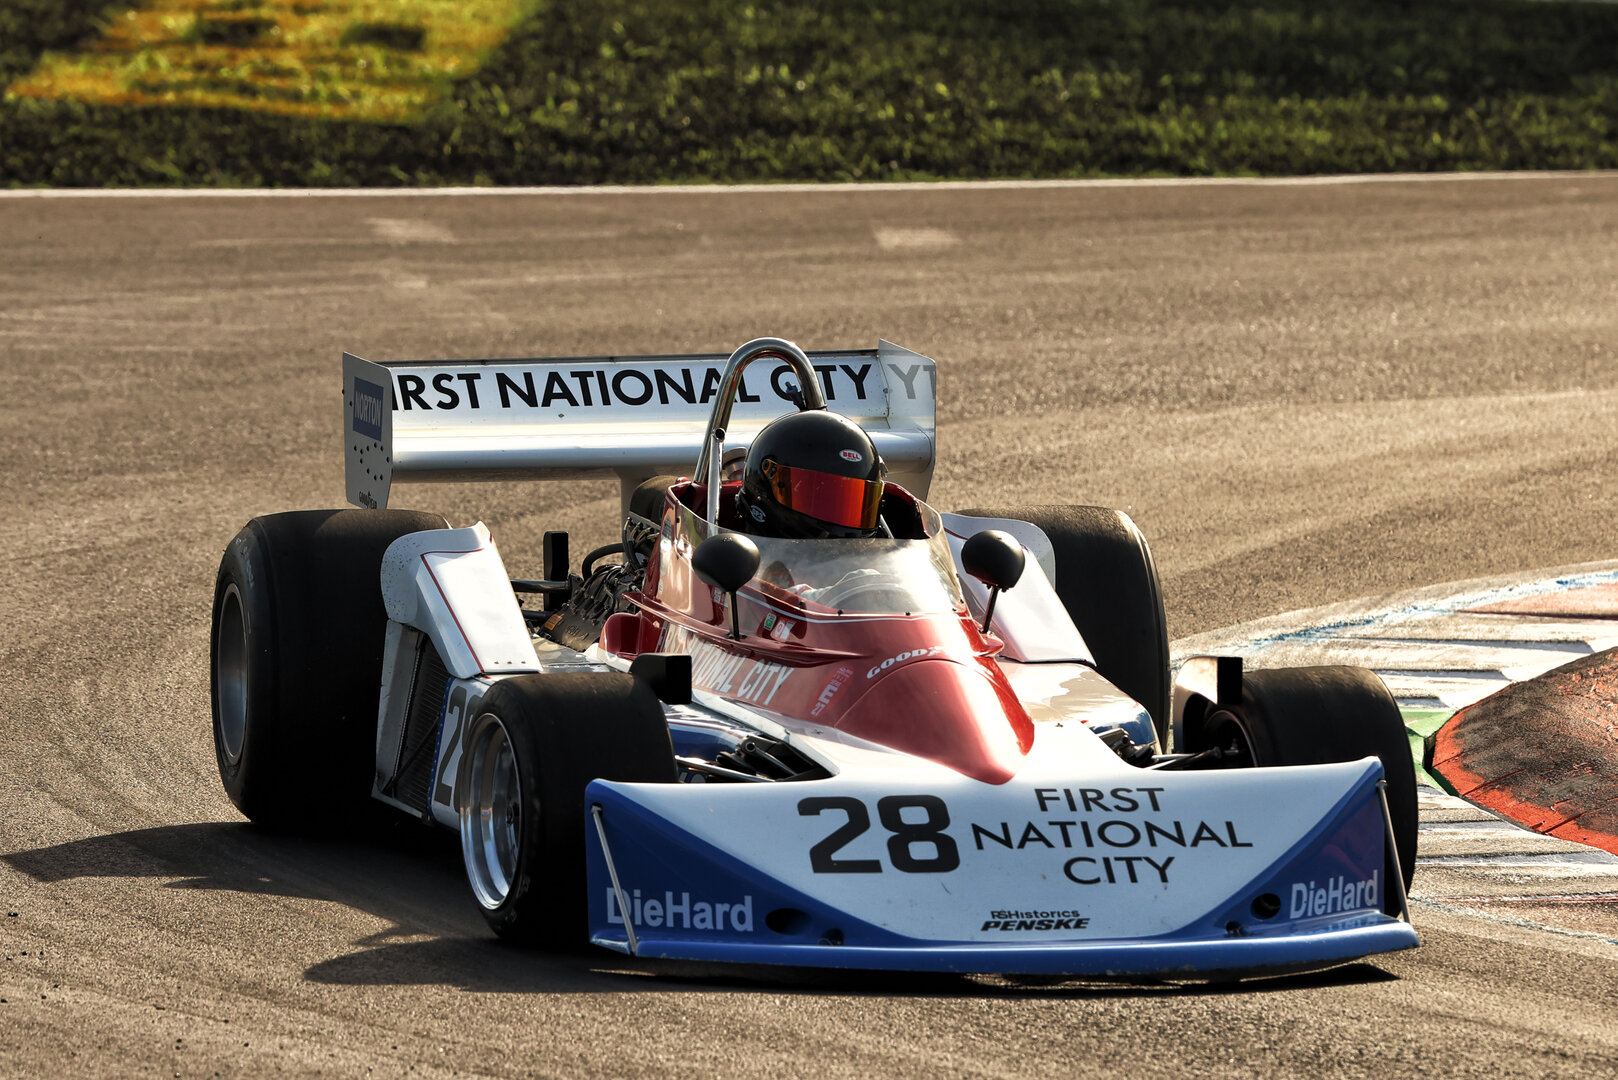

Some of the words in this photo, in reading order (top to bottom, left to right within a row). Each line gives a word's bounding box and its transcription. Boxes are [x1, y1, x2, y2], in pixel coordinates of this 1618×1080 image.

[495, 367, 761, 409] NATIONAL
[770, 364, 872, 402] CTY
[354, 391, 381, 427] NORTON
[842, 451, 861, 460] BELL
[737, 657, 795, 706] CITY
[1034, 787, 1164, 812] FIRST
[797, 794, 960, 873] 28
[971, 820, 1253, 850] NATIONAL
[1063, 856, 1175, 885] CITY
[606, 886, 753, 932] DieHard
[1289, 870, 1379, 920] DieHard
[981, 918, 1090, 931] PENSKE
